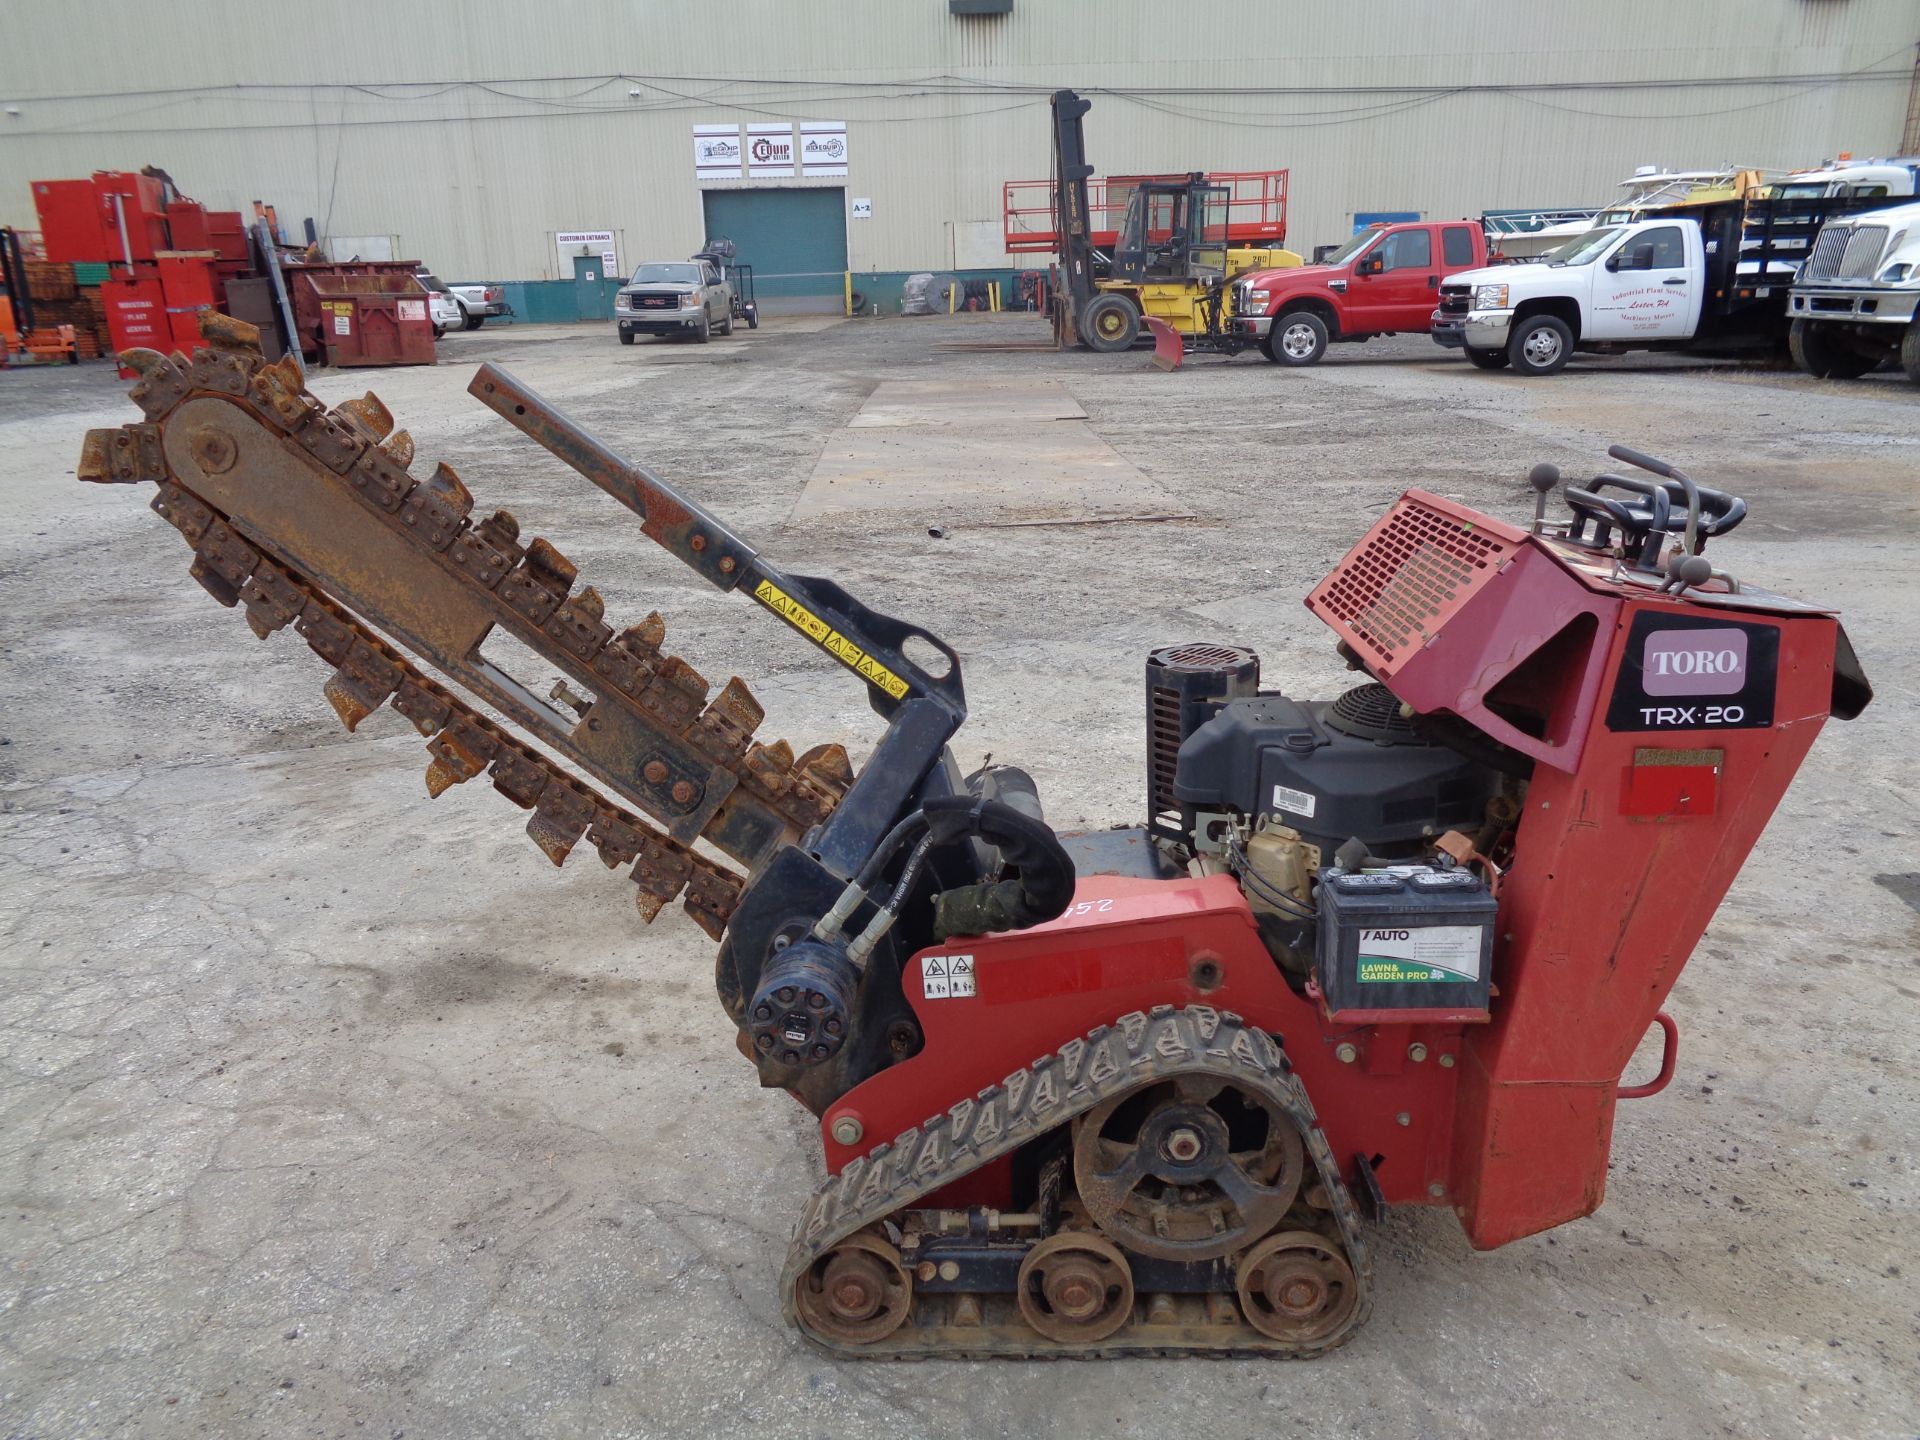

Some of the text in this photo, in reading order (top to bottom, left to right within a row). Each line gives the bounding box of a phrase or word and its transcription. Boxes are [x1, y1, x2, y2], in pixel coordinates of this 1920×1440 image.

[761, 144, 790, 156] EQUIP
[853, 204, 871, 212] A-2
[1612, 288, 1644, 301] Industrial
[1665, 287, 1688, 298] Service
[1656, 299, 1670, 308] PA
[1620, 313, 1651, 321] Machinery
[1652, 649, 1738, 675] TORO
[1372, 930, 1410, 941] AUTO
[1361, 971, 1429, 981] GARDEN PRO
